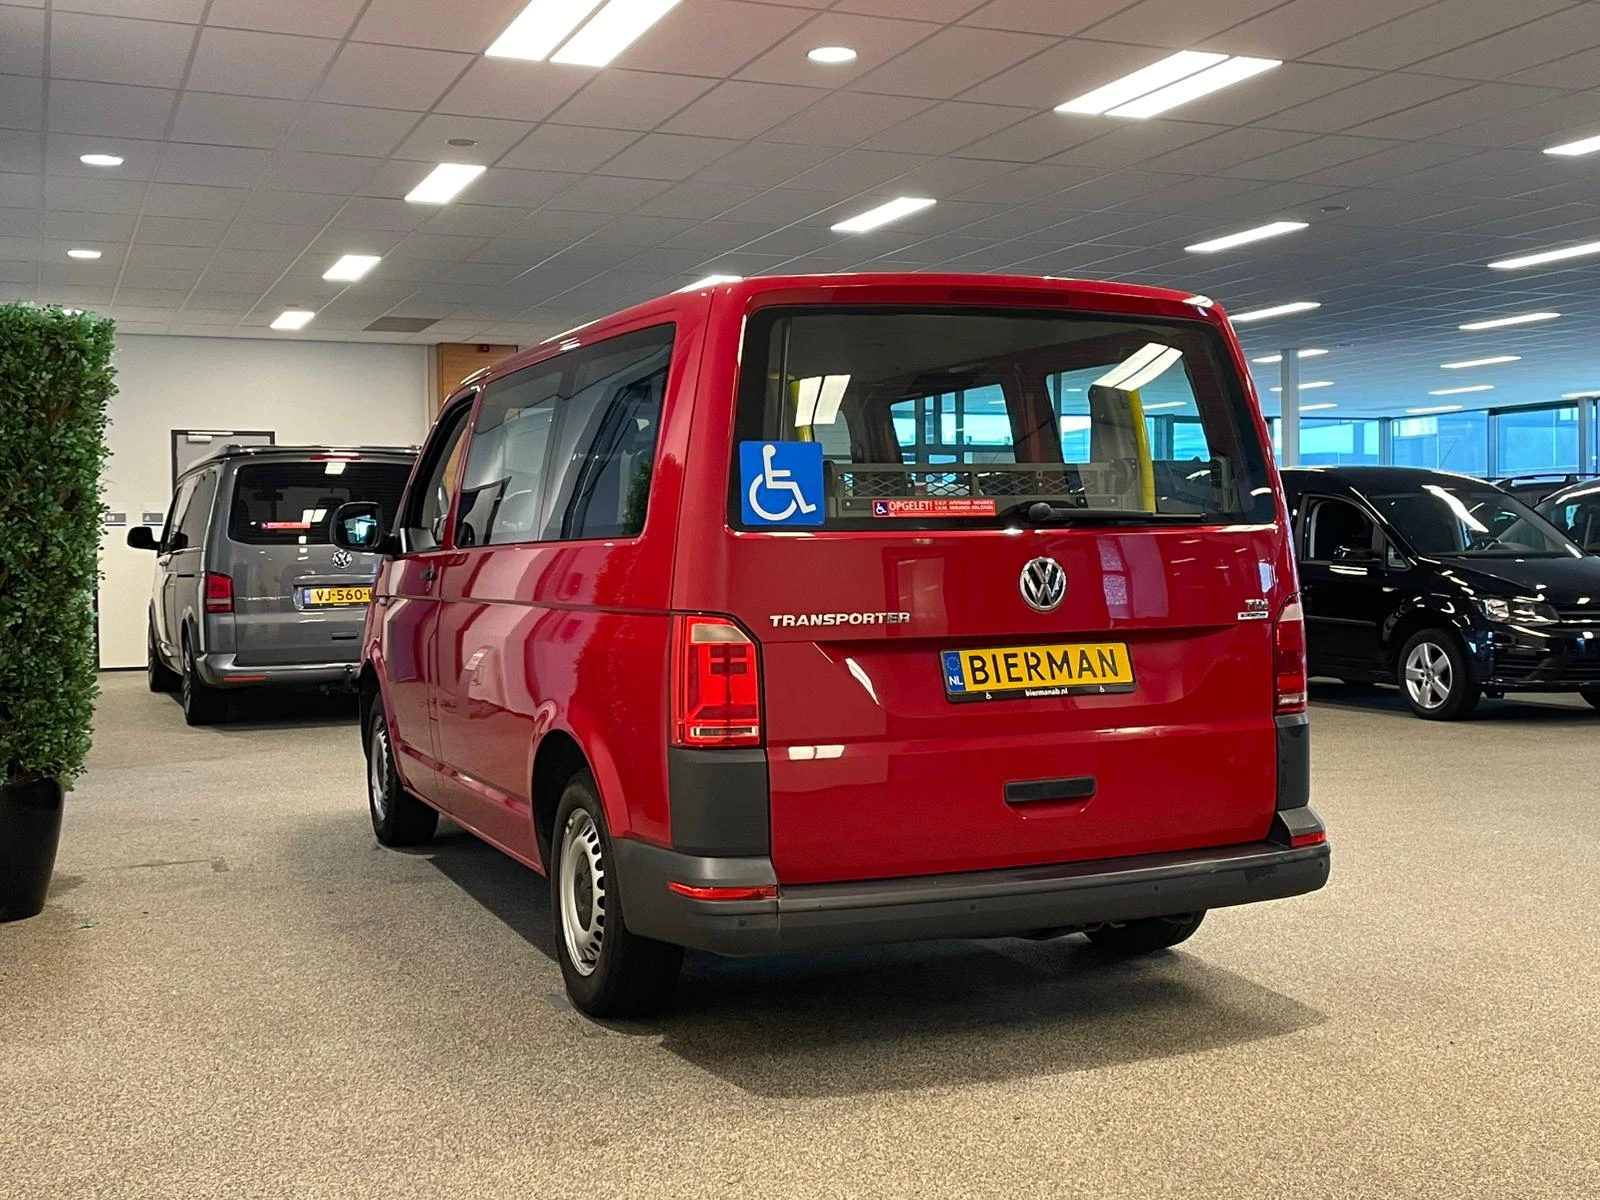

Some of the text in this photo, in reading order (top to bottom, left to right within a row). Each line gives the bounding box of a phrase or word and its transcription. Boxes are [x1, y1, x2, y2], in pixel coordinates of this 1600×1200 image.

[889, 500, 932, 511] OPGELET!
[769, 612, 911, 628] TRANSPORTER
[968, 647, 1120, 685] BIERMAN
[949, 675, 964, 686] NL
[1025, 688, 1068, 697] biermanab.nl
